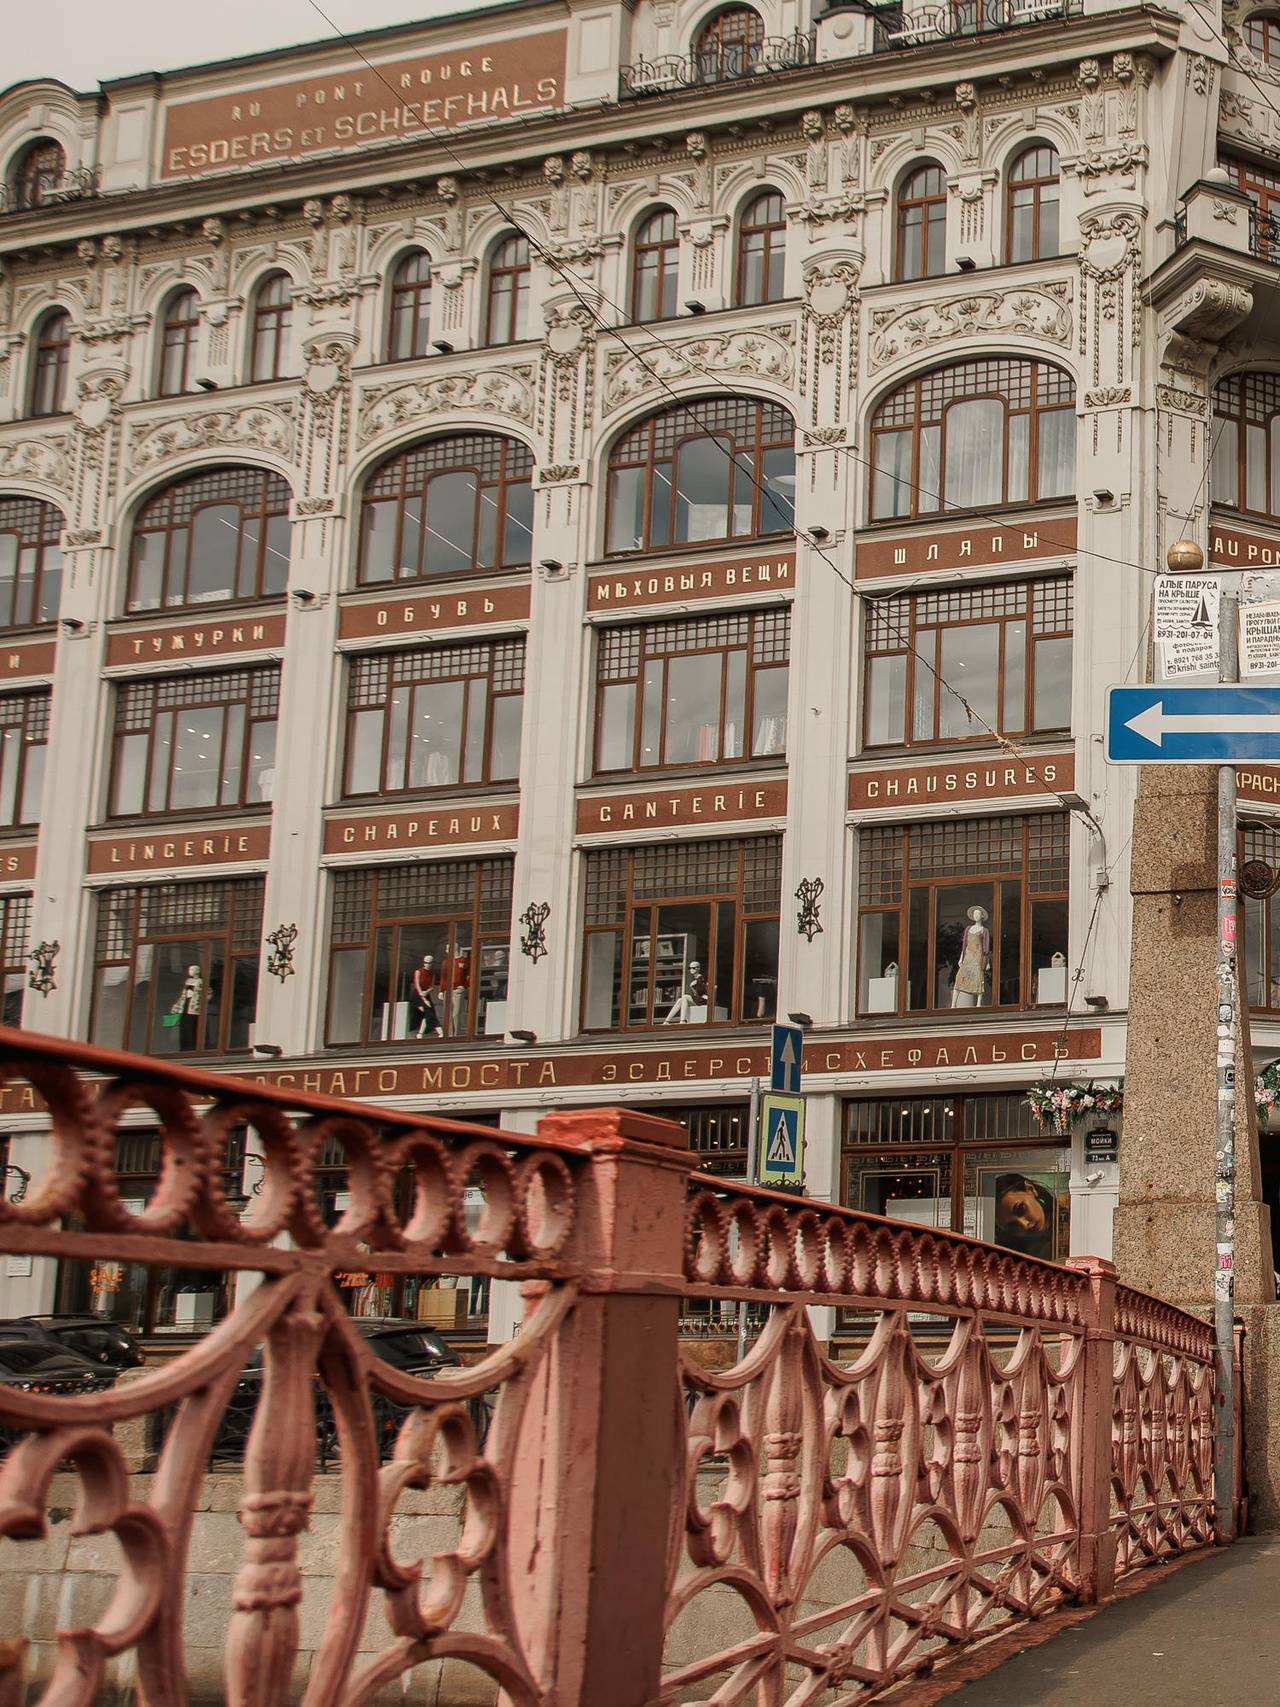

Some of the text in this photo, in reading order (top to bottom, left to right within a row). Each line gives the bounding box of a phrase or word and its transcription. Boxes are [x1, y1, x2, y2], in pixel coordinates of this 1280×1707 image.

[232, 57, 493, 121] AU PONT ROUGE
[169, 128, 293, 171] ESDERS
[335, 77, 558, 140] SCHEEFHALS
[894, 532, 1039, 564] ШЛЯПЫ
[1214, 537, 1238, 557] AU
[726, 562, 788, 585] ВЕЩИ
[1159, 580, 1218, 590] АЛЫЕ ПАРУСА
[1158, 590, 1200, 598] НА КРЫШЕ
[377, 598, 495, 627] ОБУВЬ
[133, 625, 265, 655] ТУЖУРКИ
[1157, 630, 1213, 640] 8931-201-07-04
[867, 764, 1057, 798] CHAUSSURES
[344, 814, 502, 844] CHAPEAUX
[423, 1060, 556, 1089] МОСТА
[825, 1041, 1070, 1071] СХЕФАЛЬСЪ
[1090, 1137, 1113, 1145] МОЙКИ
